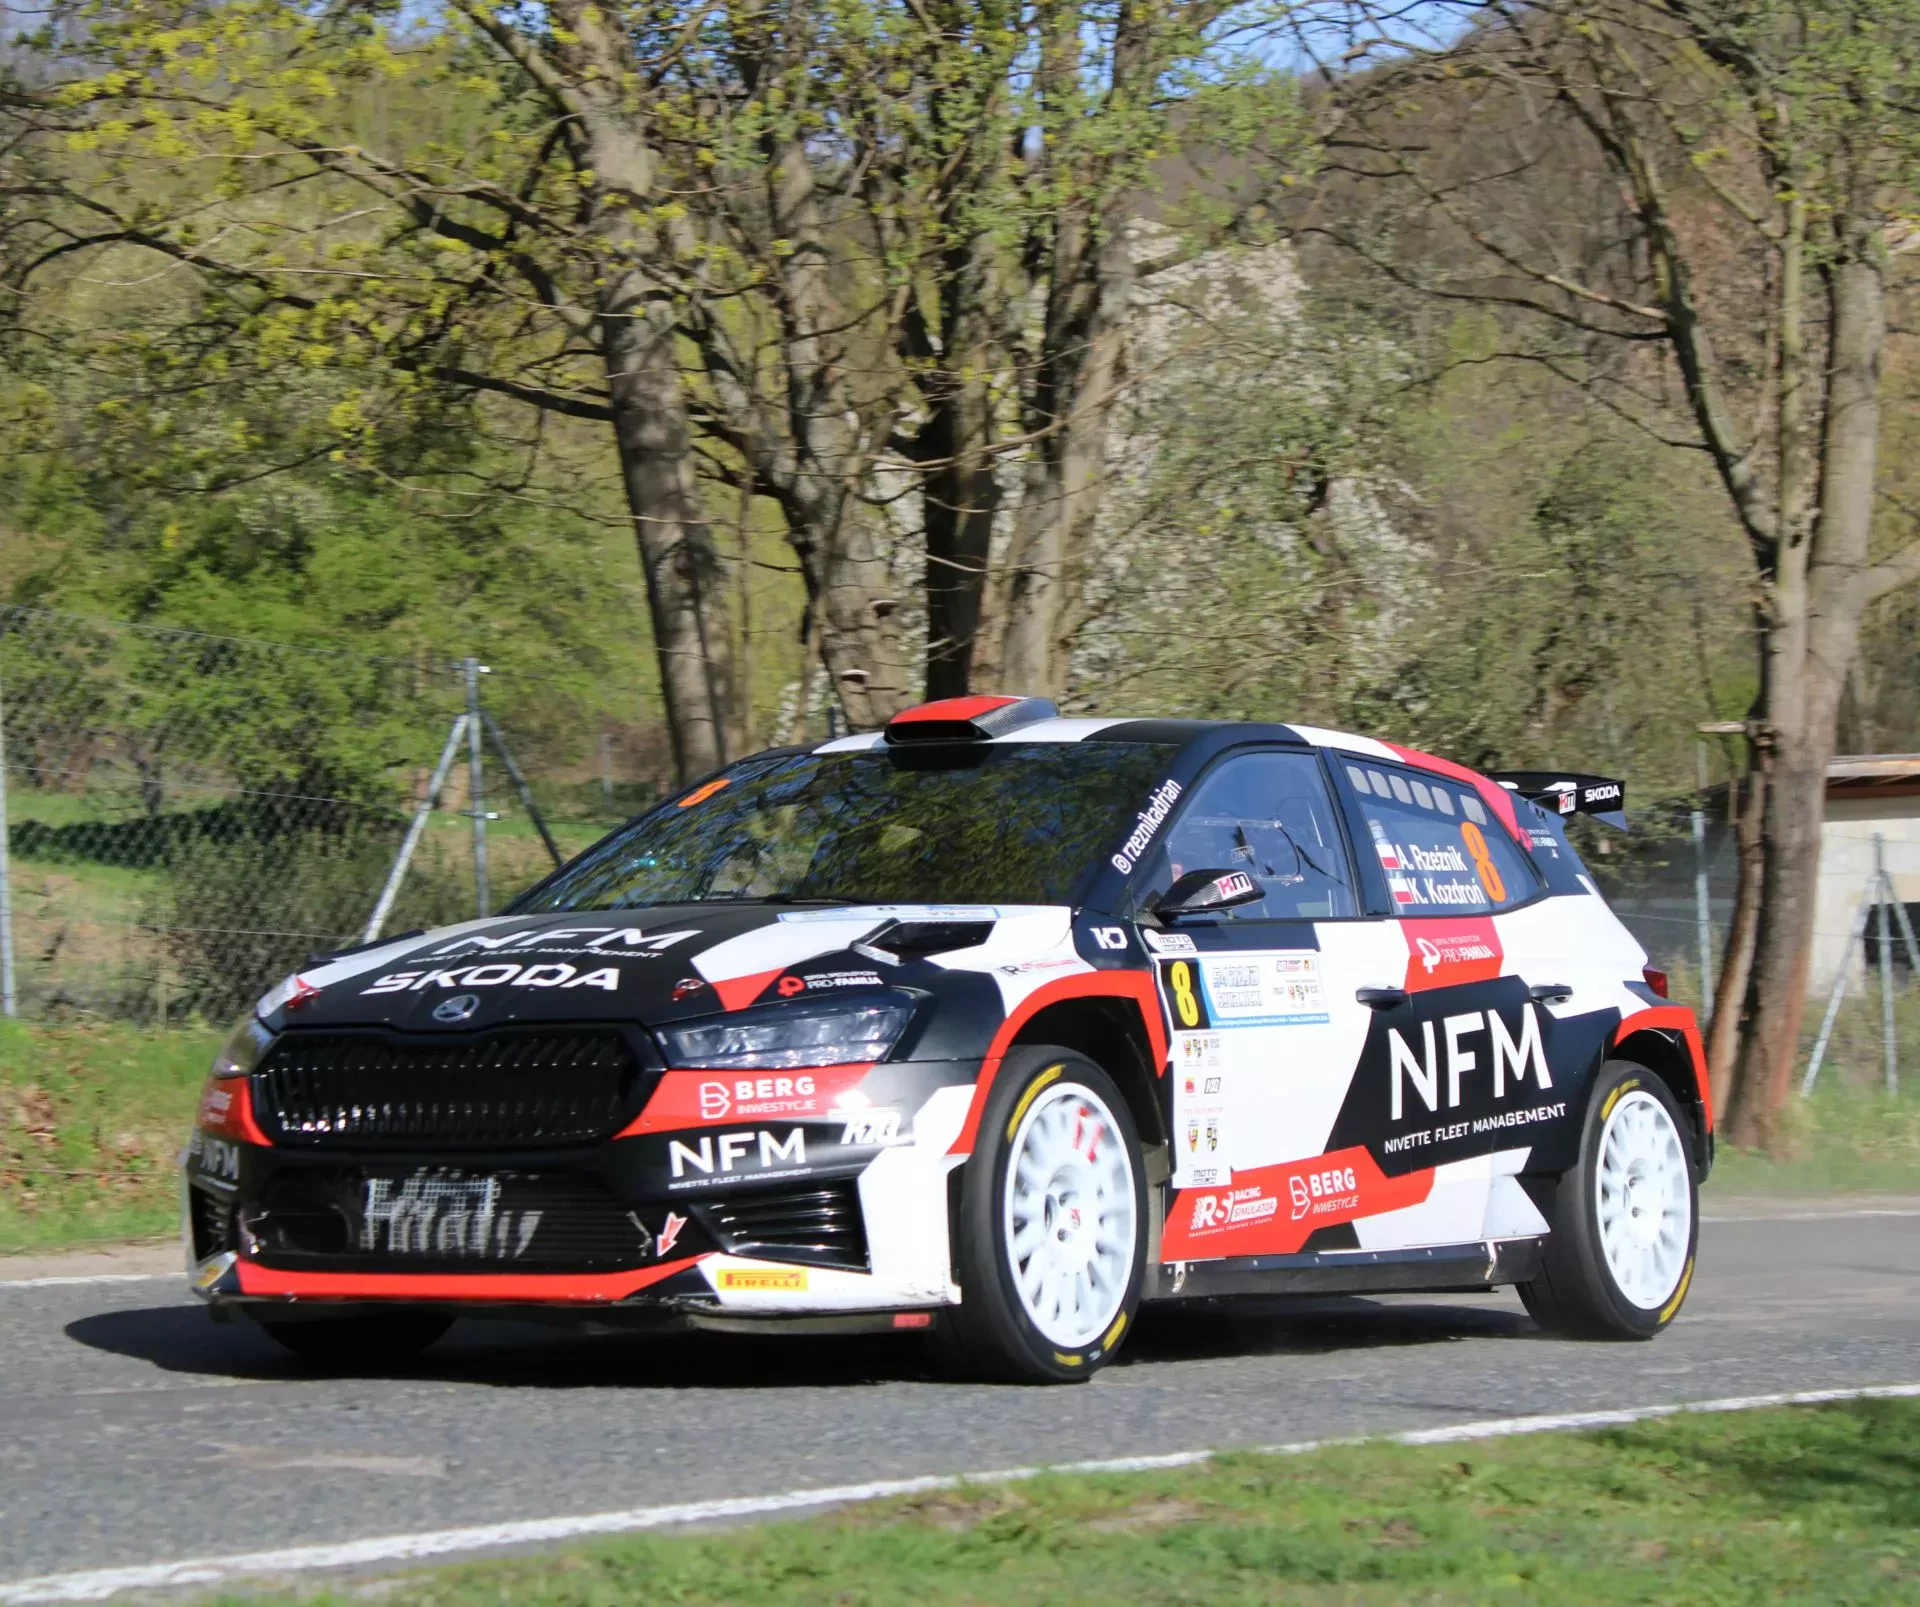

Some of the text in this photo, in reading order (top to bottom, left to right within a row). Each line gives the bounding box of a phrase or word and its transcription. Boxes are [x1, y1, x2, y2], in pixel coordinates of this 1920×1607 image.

[1584, 784, 1621, 803] SKODA
[1395, 843, 1468, 871] A. Rzeźnik
[1461, 821, 1506, 902] 8
[1406, 877, 1487, 904] K. Kozdroń
[432, 927, 703, 955] NFM
[359, 963, 620, 995] SKODA
[1171, 960, 1199, 1027] 8
[1388, 1003, 1553, 1120] NFM
[735, 1077, 815, 1100] BERG
[737, 1101, 817, 1115] INWESTYCJE
[1384, 1102, 1567, 1154] NIVETTE FLEET MANAGEMENT
[669, 1127, 806, 1178] NFM
[1234, 1186, 1262, 1201] RACING
[1309, 1168, 1357, 1198] BERG
[1234, 1201, 1275, 1218] SIMULATOR
[1312, 1195, 1360, 1215] INWESTYCJE
[725, 1273, 800, 1286] PIRELLI
